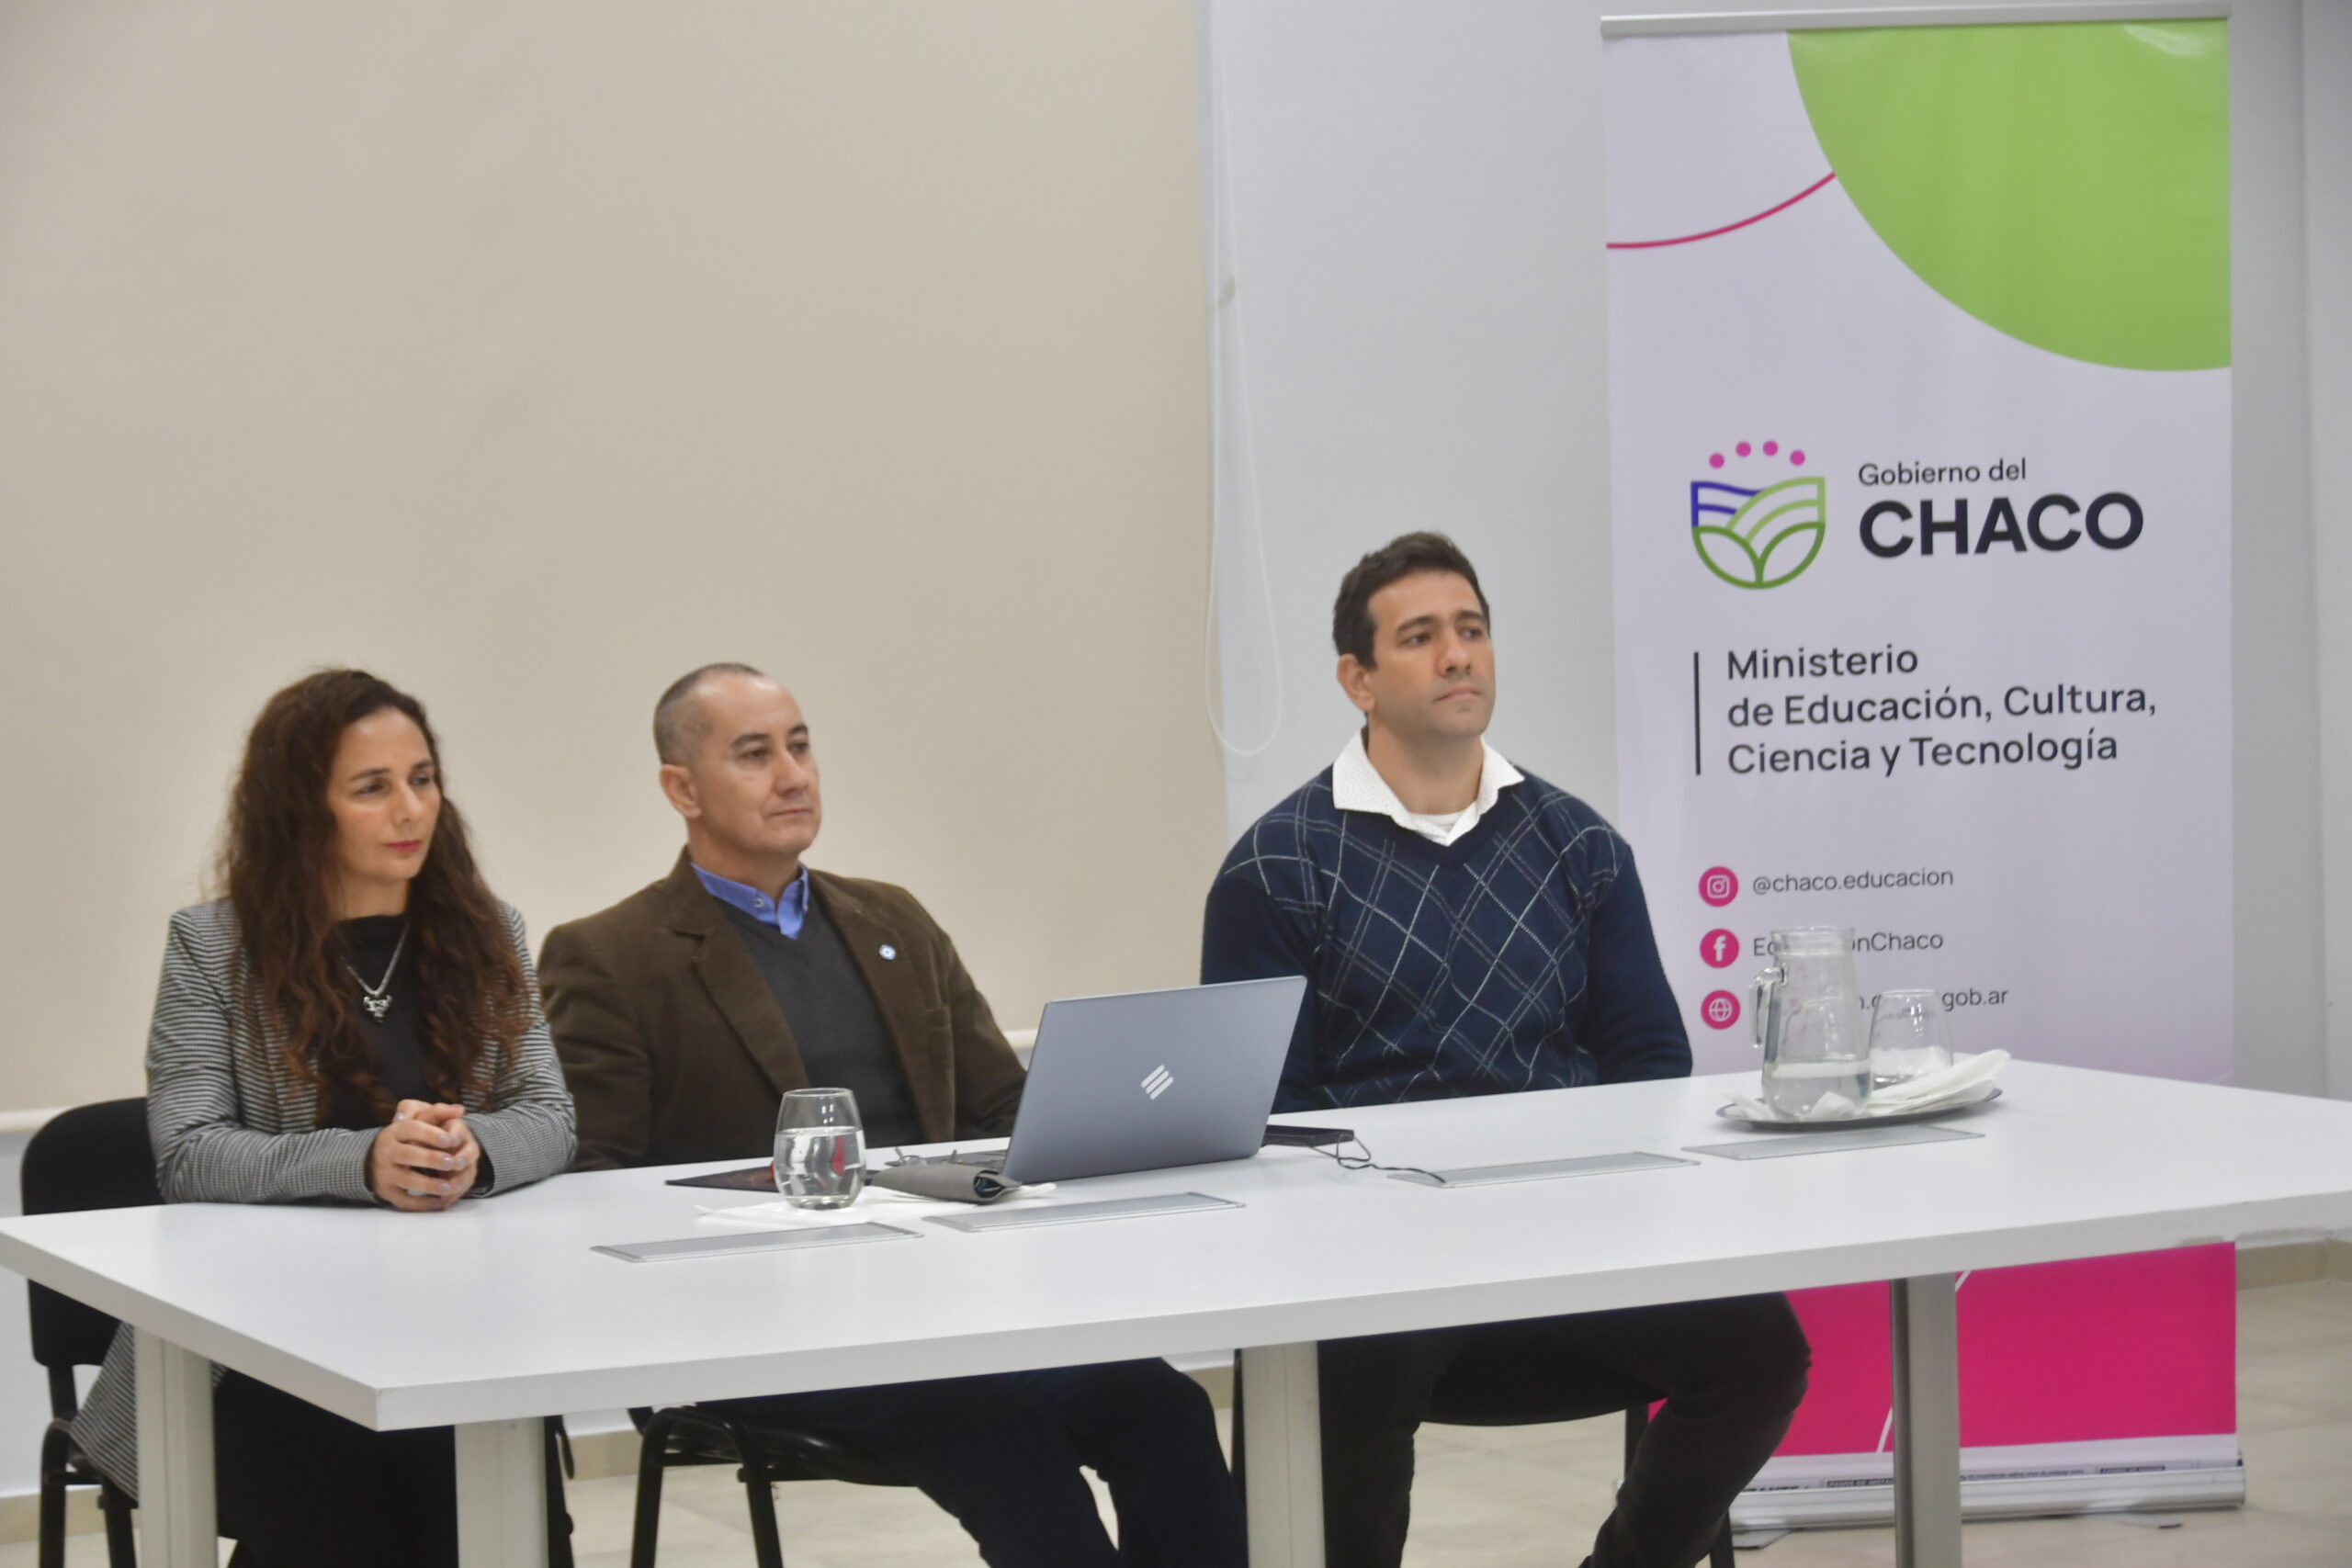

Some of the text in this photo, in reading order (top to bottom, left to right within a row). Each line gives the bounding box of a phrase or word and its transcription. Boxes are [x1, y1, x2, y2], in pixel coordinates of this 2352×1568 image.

[1858, 457, 2027, 487] Gobierno del
[1859, 491, 2144, 558] CHACO
[1727, 644, 1918, 681] Ministerio
[1727, 683, 2156, 728] de Educación, Cultura,
[1727, 728, 2118, 778] Ciencia y Tecnología
[1752, 868, 1954, 896] @chaco.educacion
